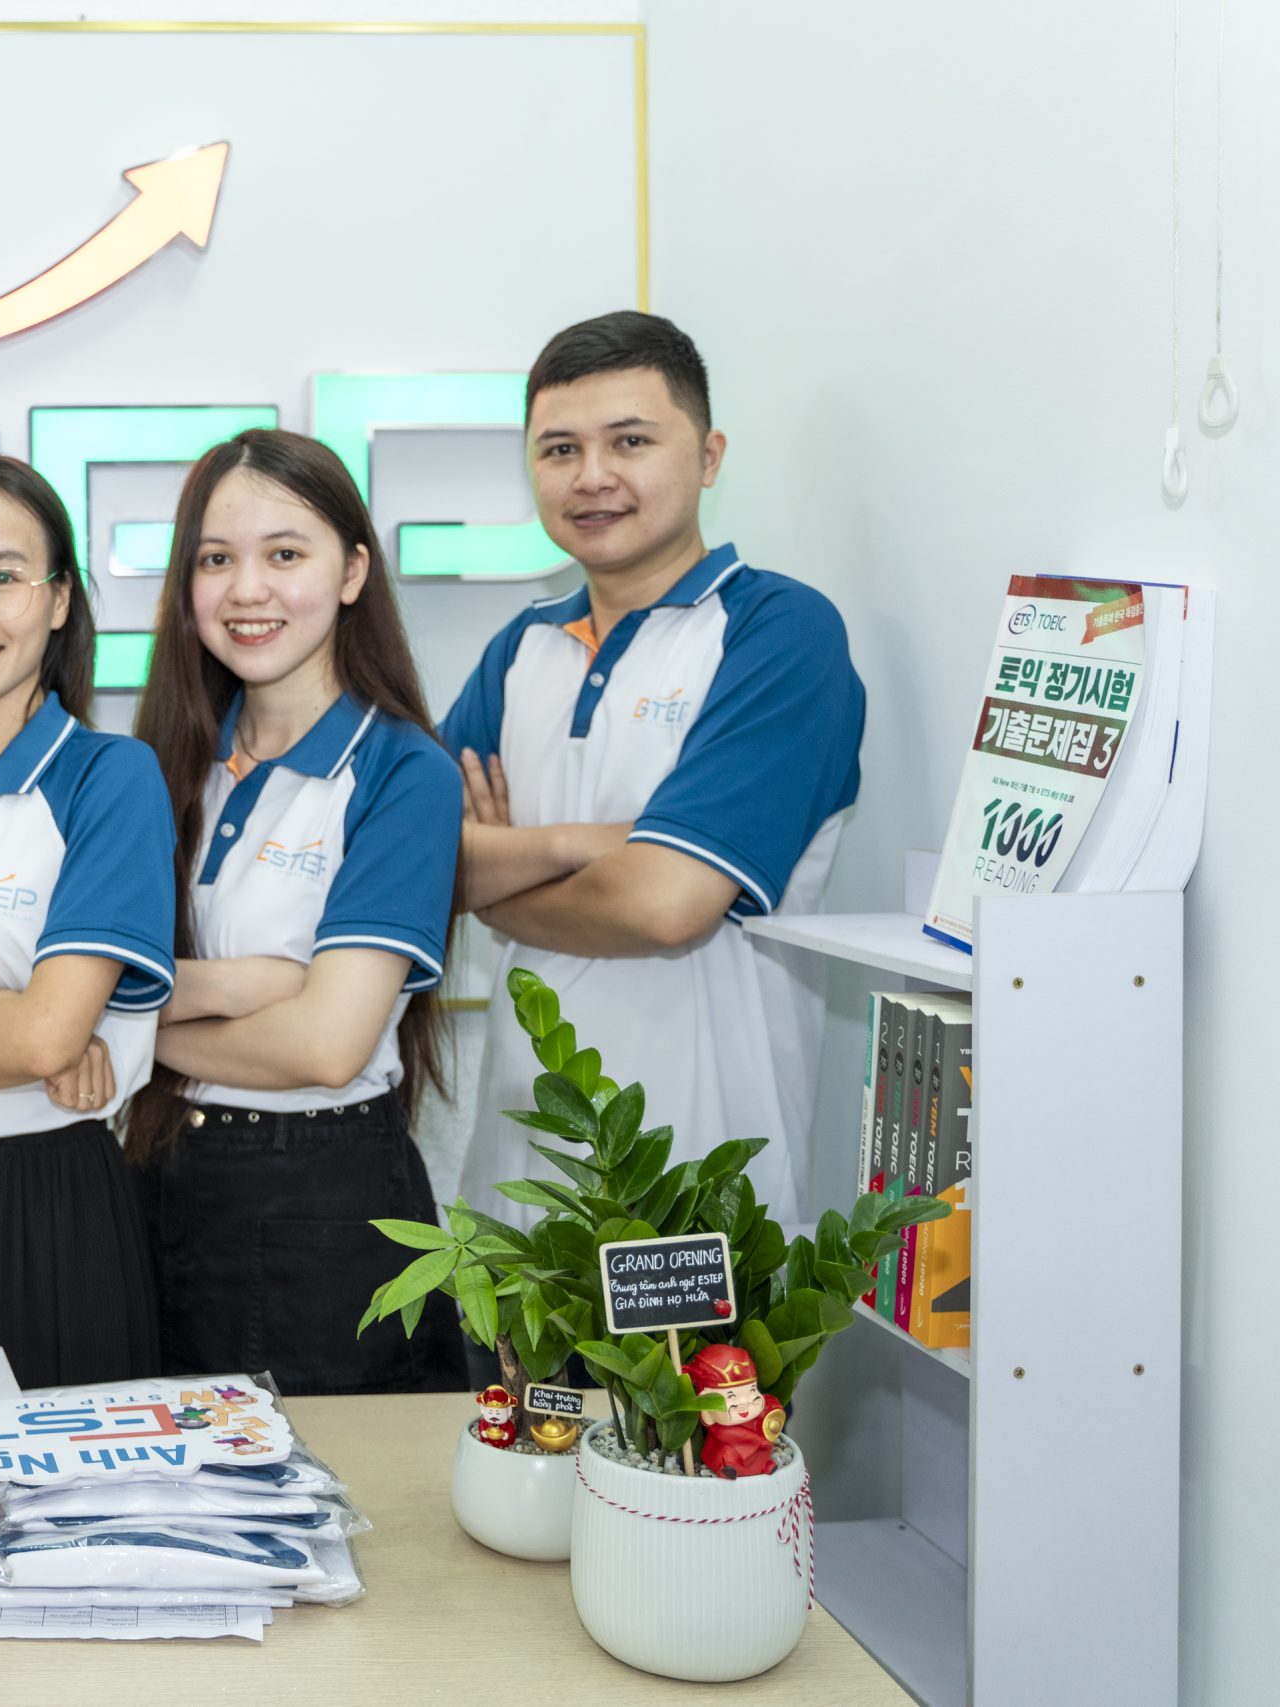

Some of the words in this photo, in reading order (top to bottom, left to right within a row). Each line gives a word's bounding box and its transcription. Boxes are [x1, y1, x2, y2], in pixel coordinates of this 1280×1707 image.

[1013, 612, 1032, 627] ETS
[1037, 613, 1067, 631] TOEIC
[995, 656, 1045, 698] 토익
[1044, 661, 1135, 712] 정기시험
[982, 707, 1098, 766] 기출문제집
[1093, 727, 1120, 770] 3
[981, 798, 1063, 868] 1000
[972, 856, 1040, 894] READING
[929, 1095, 938, 1137] YBM
[874, 1116, 883, 1168] TOEIC
[890, 1122, 900, 1175] TOEIC
[908, 1131, 918, 1184] TOEIC
[925, 1140, 935, 1195] TOEIC
[611, 1253, 664, 1274] GRAND
[669, 1247, 722, 1269] OPENING
[639, 1280, 657, 1291] tâm
[658, 1276, 677, 1290] anh
[697, 1272, 723, 1285] ESTEP
[615, 1297, 636, 1310] GIA
[638, 1293, 663, 1309] ĐÌNH
[667, 1295, 682, 1308] HỌ
[15, 1400, 56, 1410] UP
[79, 1393, 161, 1406] STEP
[78, 1444, 187, 1471] Anh
